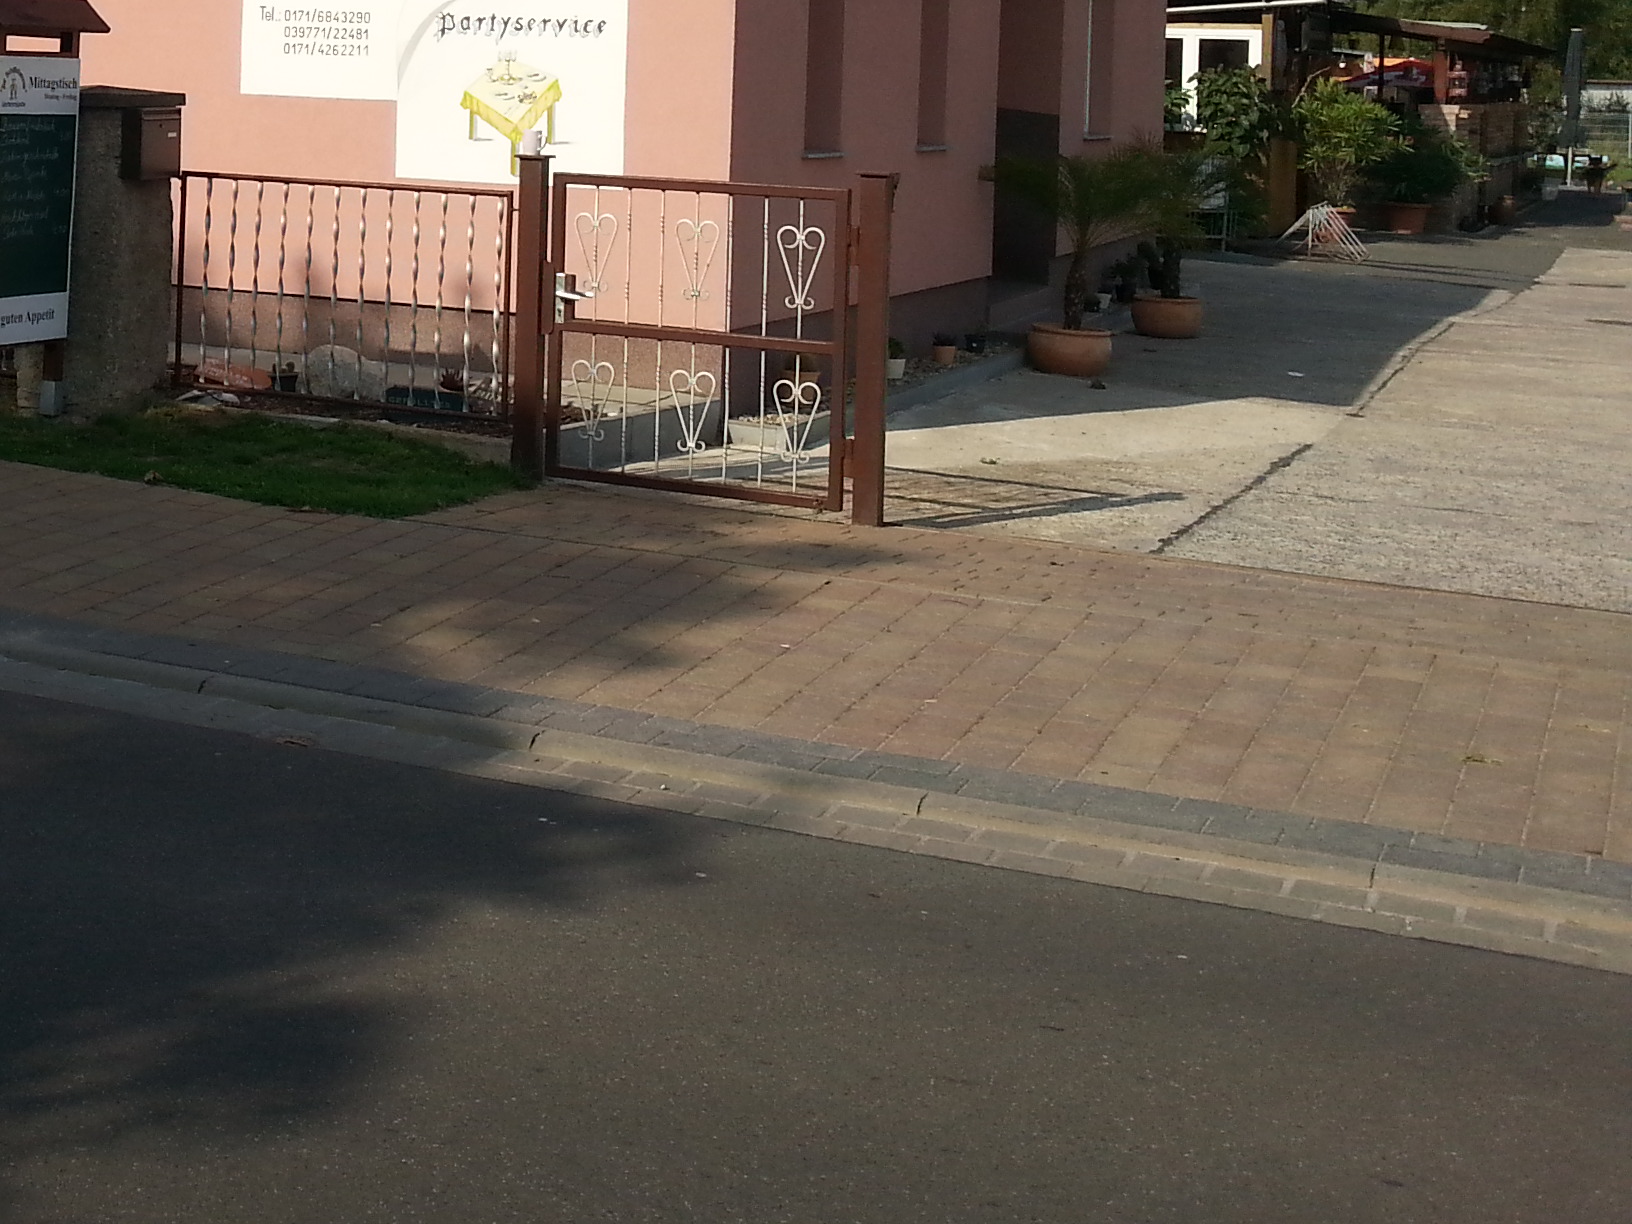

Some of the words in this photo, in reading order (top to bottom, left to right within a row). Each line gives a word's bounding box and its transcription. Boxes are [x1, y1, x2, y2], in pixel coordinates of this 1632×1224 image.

[284, 8, 371, 24] 0171/6843290
[283, 25, 370, 40] 039771/22481
[283, 41, 369, 57] 0171/4262211
[29, 76, 78, 93] Mittagstisch
[0, 314, 23, 328] guten
[24, 308, 55, 325] Appetit
